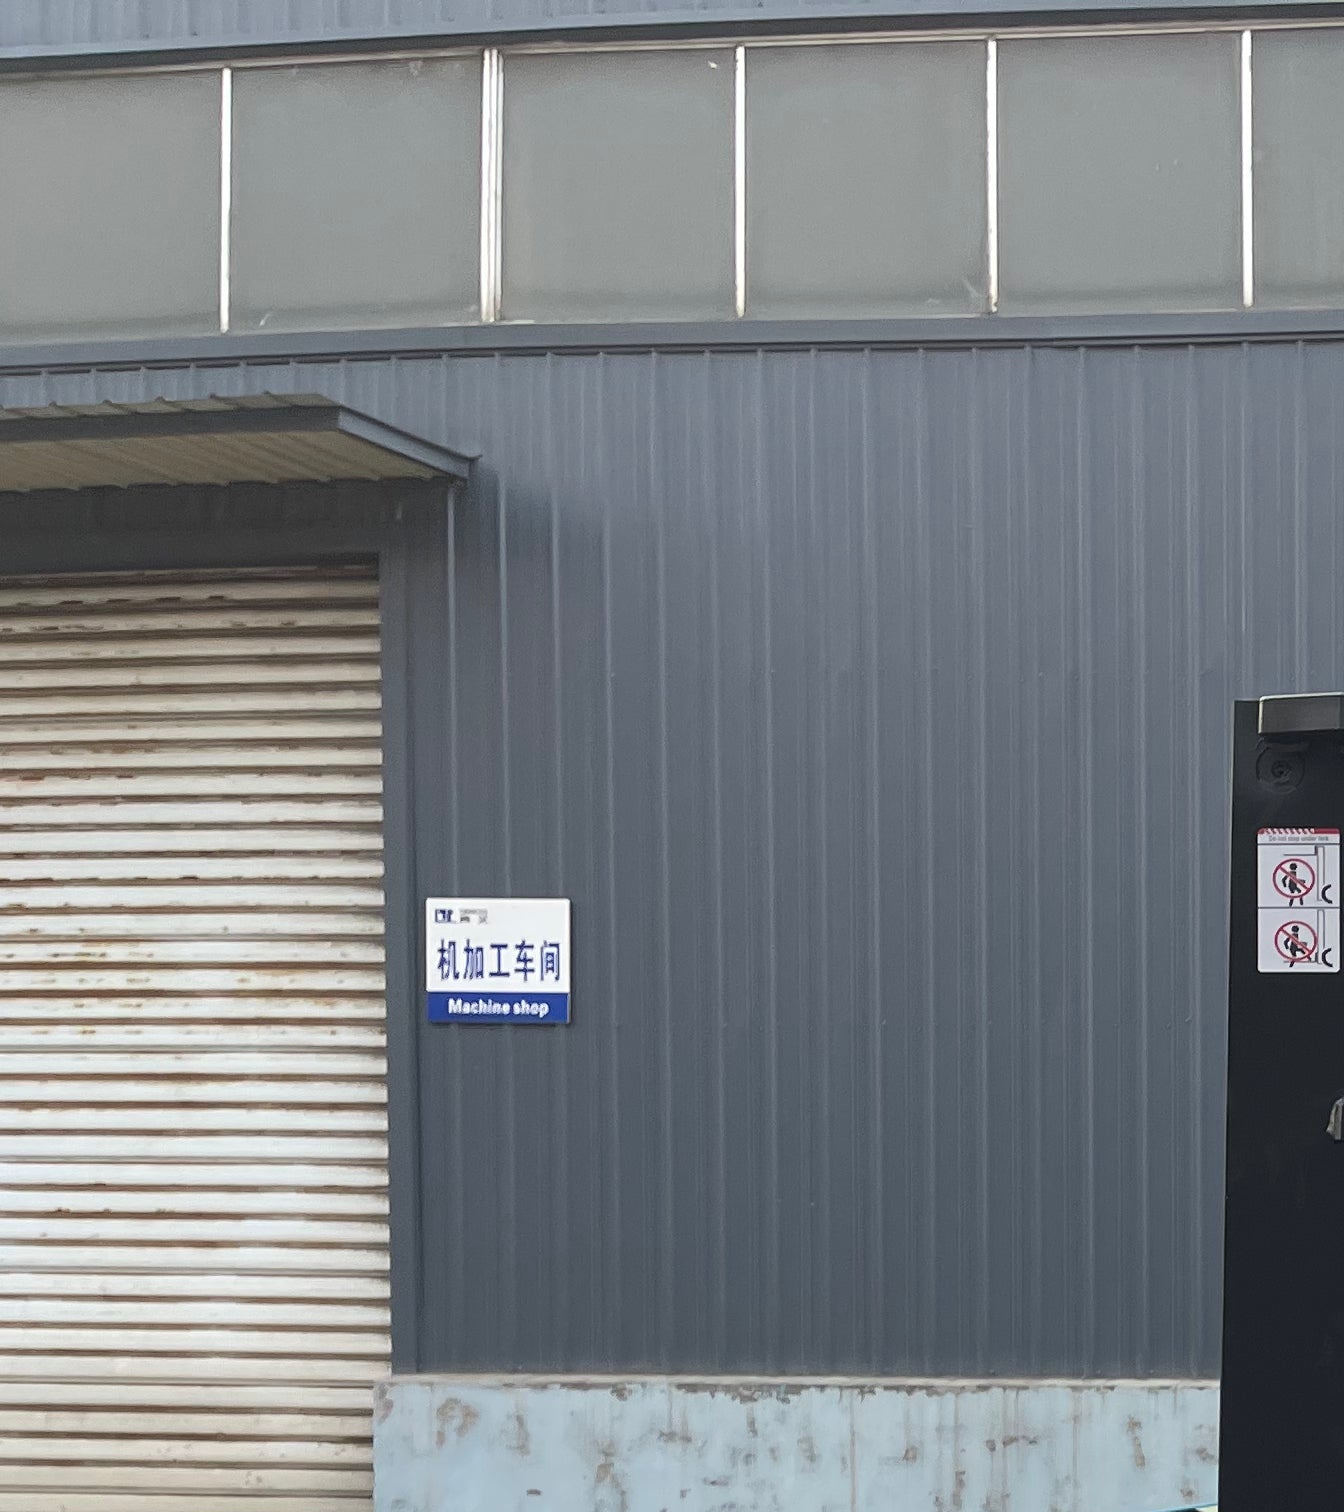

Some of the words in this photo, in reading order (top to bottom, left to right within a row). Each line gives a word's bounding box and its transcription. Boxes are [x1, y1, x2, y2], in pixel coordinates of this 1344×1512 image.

[438, 938, 560, 982] 机加工车间
[448, 998, 510, 1014] Machine
[512, 999, 549, 1018] shop
